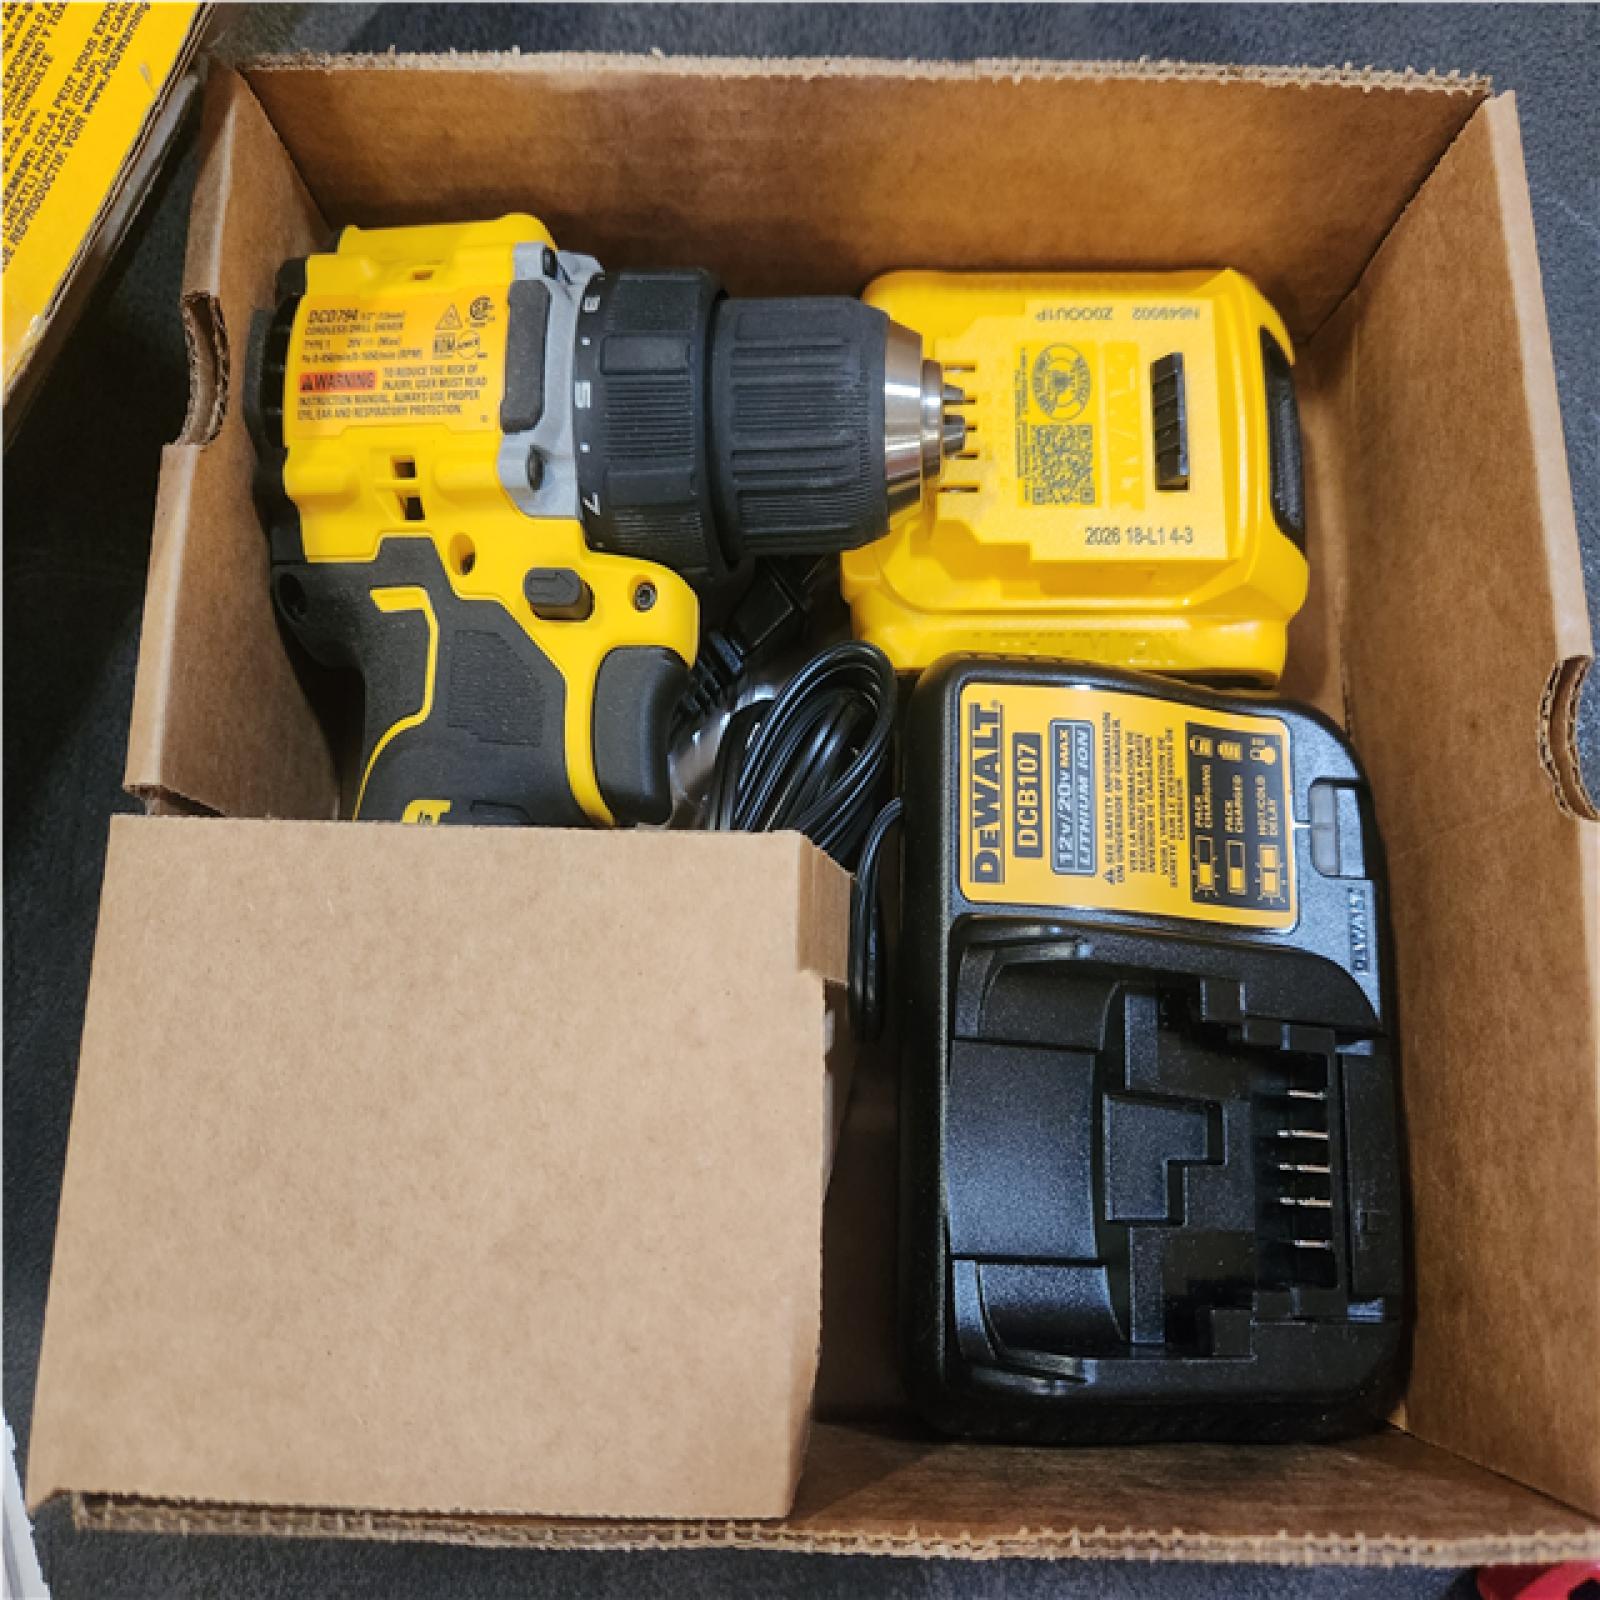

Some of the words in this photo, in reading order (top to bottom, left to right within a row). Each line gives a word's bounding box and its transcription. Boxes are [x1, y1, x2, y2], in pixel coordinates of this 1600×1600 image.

[97, 34, 114, 55] UN
[9, 52, 54, 120] CONSULTE
[31, 110, 59, 147] CELA
[50, 74, 78, 110] PEUT
[71, 36, 99, 74] VOUS
[60, 114, 88, 150] VOIR
[308, 309, 358, 323] DCD794
[315, 372, 374, 389] WARNING
[396, 367, 427, 377] REDUCE
[430, 366, 443, 375] THE
[447, 365, 465, 374] RISK
[468, 365, 478, 373] OF
[415, 379, 436, 389] USER
[439, 378, 463, 387] MUST
[465, 377, 486, 386] READ
[300, 395, 352, 406] INSTRUCTION
[394, 391, 426, 403] ALWAYS
[429, 391, 444, 401] USE
[447, 390, 480, 400] PROPER
[335, 408, 351, 418] AND
[354, 405, 408, 418] RESPIRATORY
[574, 379, 591, 408] 5
[583, 493, 600, 516] 7
[1085, 527, 1121, 545] 2026
[1125, 527, 1166, 545] 18-L1
[1169, 527, 1194, 545] 4-3
[1059, 729, 1069, 768] MAX
[1077, 730, 1089, 770] ION
[1126, 731, 1135, 745] DE
[1135, 733, 1144, 767] PARTE
[1157, 737, 1165, 751] DE
[1165, 729, 1173, 742] DE
[1103, 712, 1112, 793] INFORMATION
[1114, 777, 1122, 791] OF
[1137, 770, 1145, 785] LA
[1167, 746, 1175, 798] DESSOUS
[972, 704, 1003, 883] DEWALT
[1017, 743, 1039, 847] DCB107
[1137, 788, 1145, 803] EN
[1168, 801, 1175, 814] LE
[1202, 764, 1212, 829] CHARGING
[1233, 775, 1244, 833] CHARGED
[1256, 775, 1266, 836] HOT/COLD
[1078, 776, 1090, 866] LITHIUM
[1105, 795, 1113, 839] SAFETY
[1147, 804, 1154, 817] DE
[1194, 795, 1203, 828] PACK
[1225, 800, 1233, 832] PACK
[1268, 799, 1278, 836] DELAY
[1115, 795, 1124, 862] UNDERSIDE
[1129, 832, 1136, 847] LA
[1138, 807, 1147, 872] SEGURIDAD
[1105, 844, 1113, 864] SEE
[1129, 850, 1137, 872] VER
[1147, 820, 1156, 873] INFERIOR
[1160, 847, 1168, 875] VOIR
[1116, 865, 1125, 883] ON
